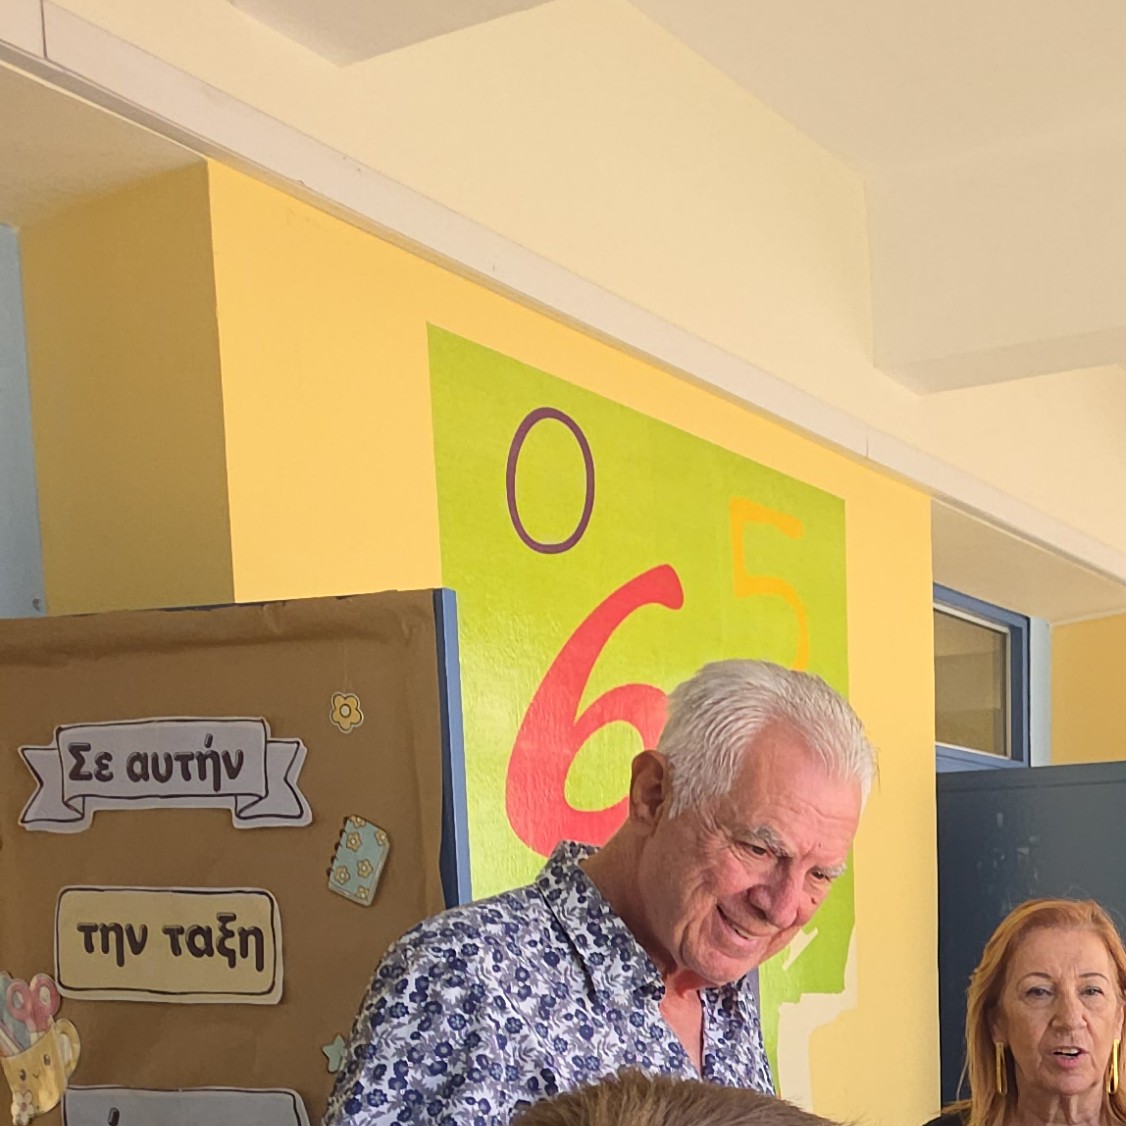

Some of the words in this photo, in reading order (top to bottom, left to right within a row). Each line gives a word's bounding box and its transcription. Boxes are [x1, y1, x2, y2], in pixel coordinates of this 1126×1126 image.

[505, 564, 684, 858] 6
[67, 742, 115, 782] Σε
[126, 733, 245, 792] αυτήν
[77, 922, 149, 968] την
[162, 912, 265, 972] ταξη
